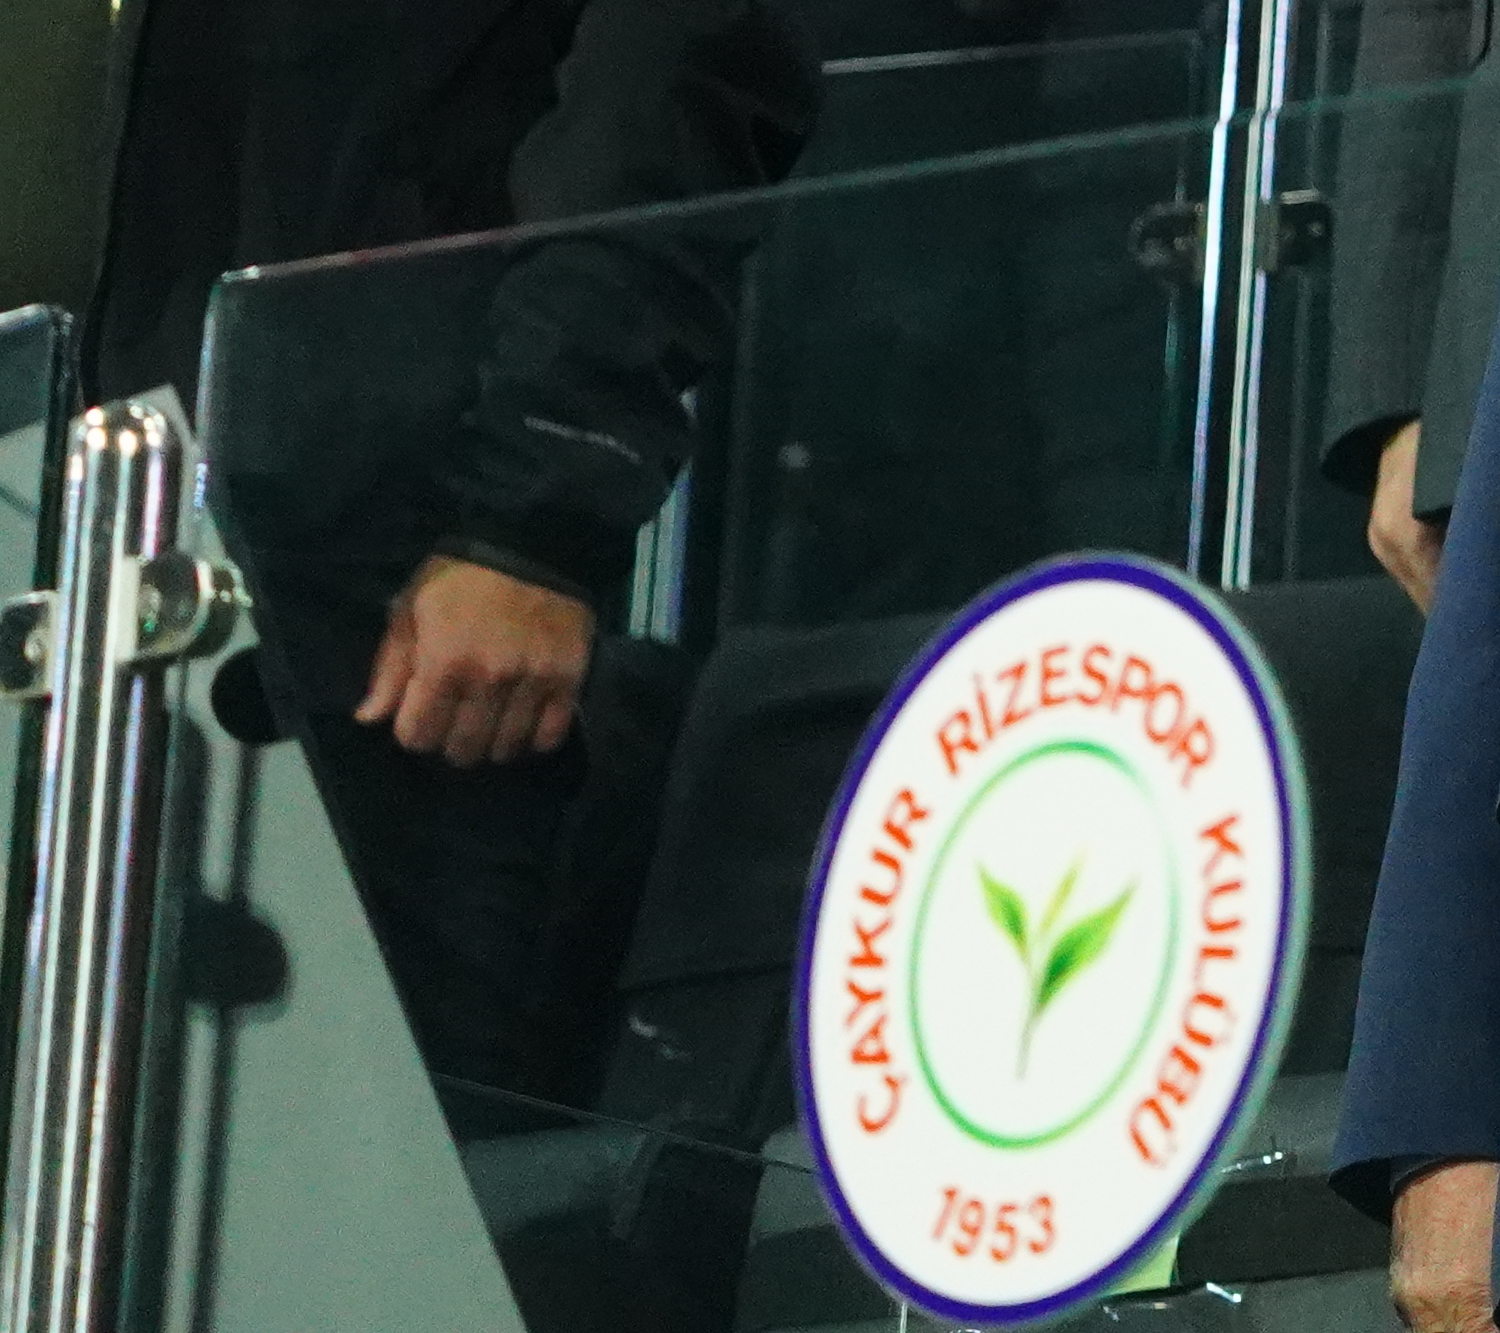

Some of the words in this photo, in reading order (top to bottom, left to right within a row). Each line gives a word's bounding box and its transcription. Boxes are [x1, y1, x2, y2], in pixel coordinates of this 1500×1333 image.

[843, 786, 932, 1135] ÇAYKUR
[934, 643, 1215, 788] RİZESPOR
[1127, 813, 1246, 1166] KULÜBÜ
[931, 1185, 1058, 1263] 1953
